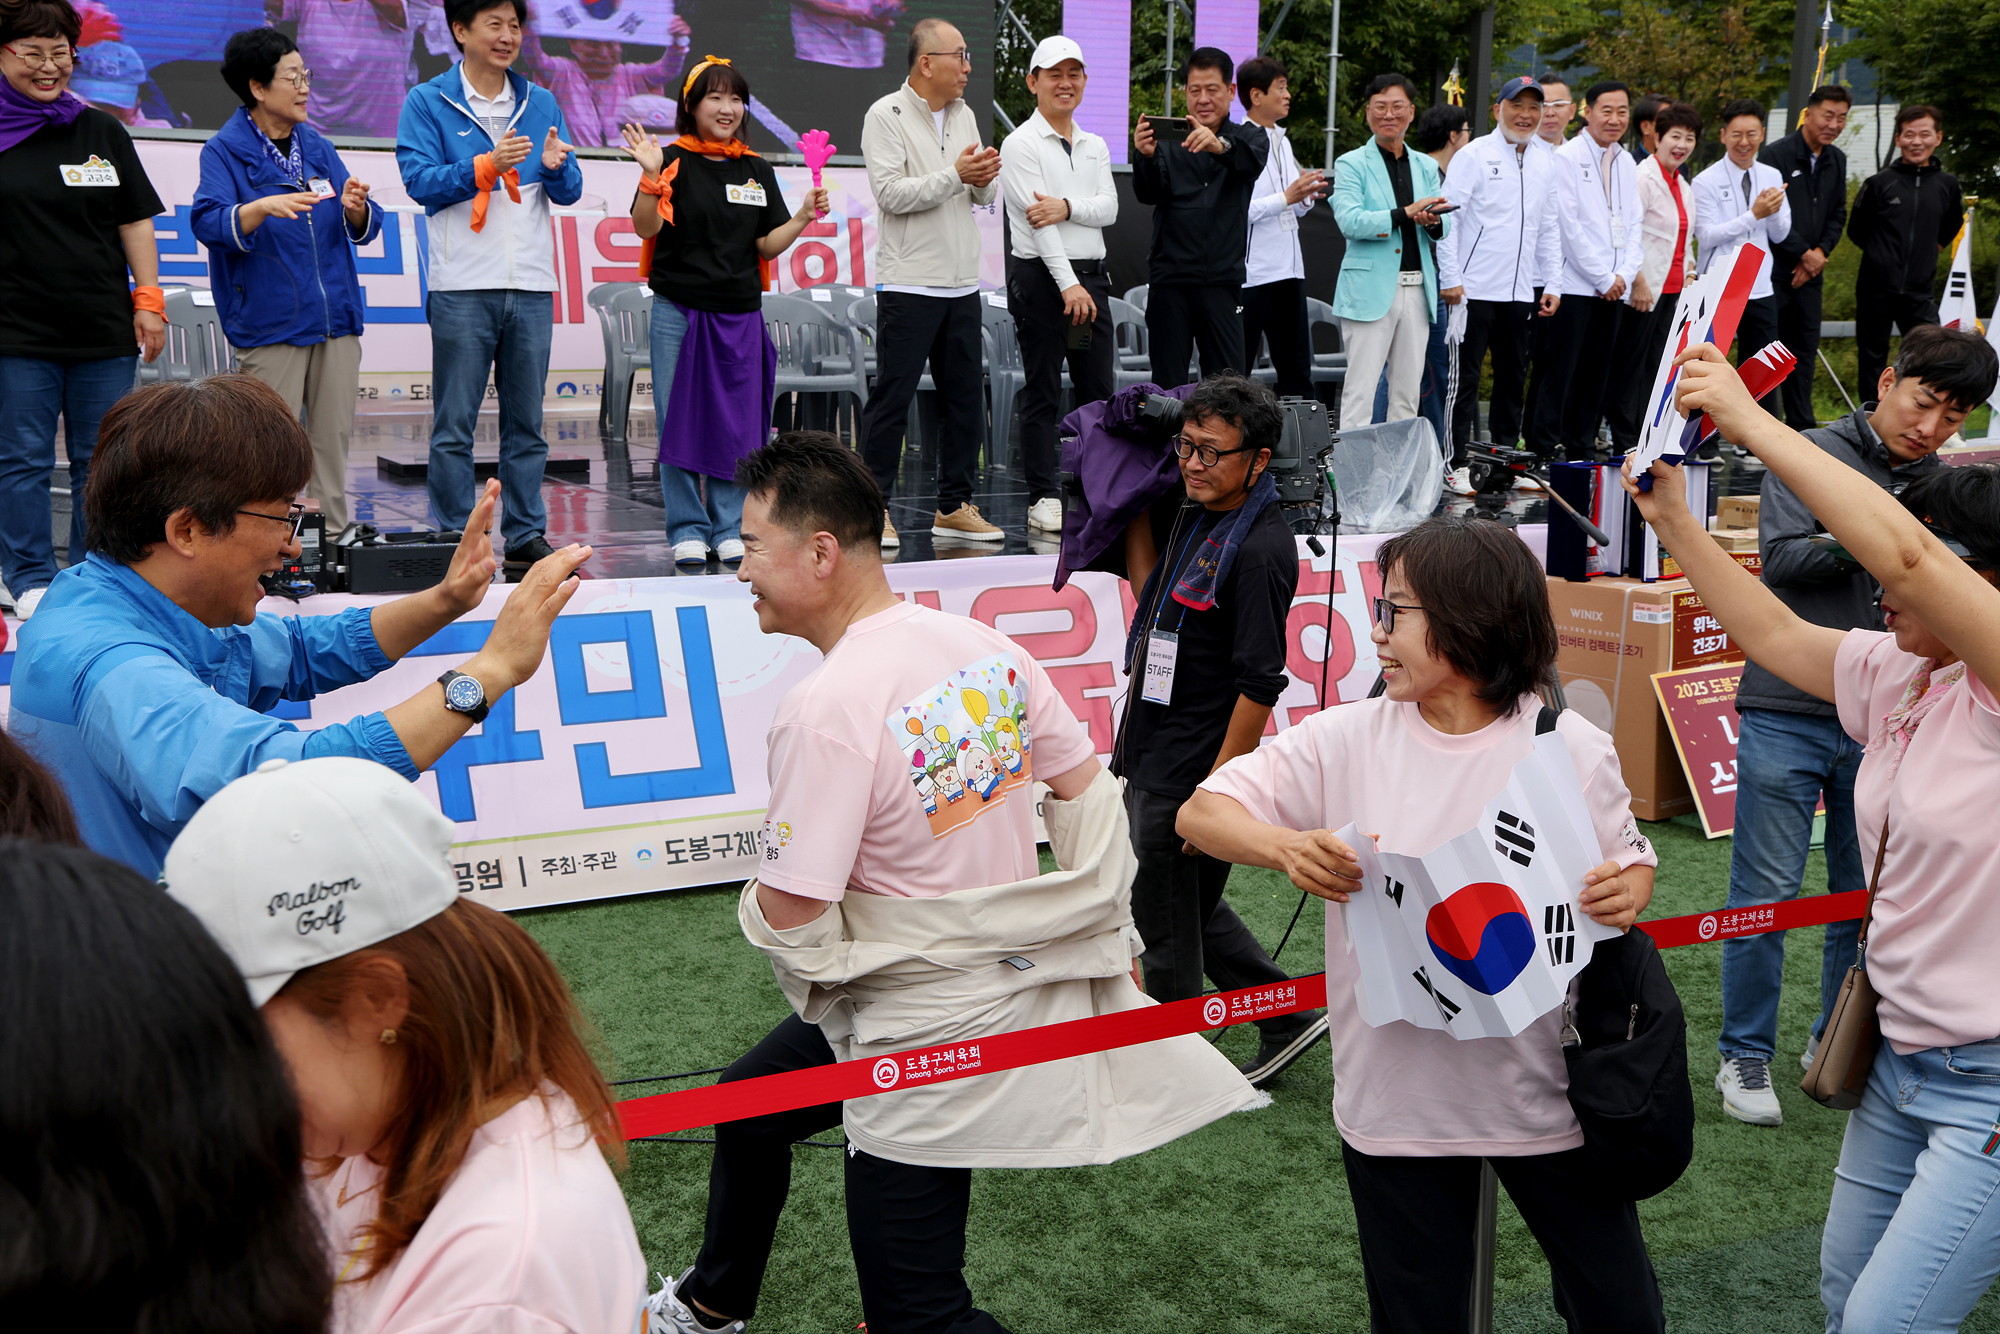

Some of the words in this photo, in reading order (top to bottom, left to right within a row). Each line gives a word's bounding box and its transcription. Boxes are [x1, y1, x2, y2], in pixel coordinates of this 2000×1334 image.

[1520, 76, 1533, 84] B
[85, 174, 113, 182] 고금숙
[1569, 607, 1604, 622] WINIX
[1559, 634, 1586, 650] 인버터
[1692, 633, 1728, 655] 건조기
[1147, 663, 1173, 678] STAFF
[1674, 679, 1709, 699] 2025
[766, 845, 779, 861] 창5
[541, 850, 618, 878] 주최·주관
[266, 877, 361, 917] Malbon
[296, 899, 347, 936] Golf
[1720, 926, 1739, 934] Dobong
[1739, 923, 1755, 932] Sports
[1755, 920, 1774, 929] Council
[1721, 908, 1775, 927] 도봉구체육회
[1231, 985, 1297, 1009] 도봉구체육회
[1231, 1008, 1254, 1018] Dobong
[1255, 1004, 1274, 1014] Sports
[1275, 999, 1297, 1010] Council
[905, 1044, 981, 1071] 도봉구체육회
[905, 1069, 932, 1080] Dobong
[933, 1065, 955, 1076] Sports
[956, 1059, 981, 1071] Council
